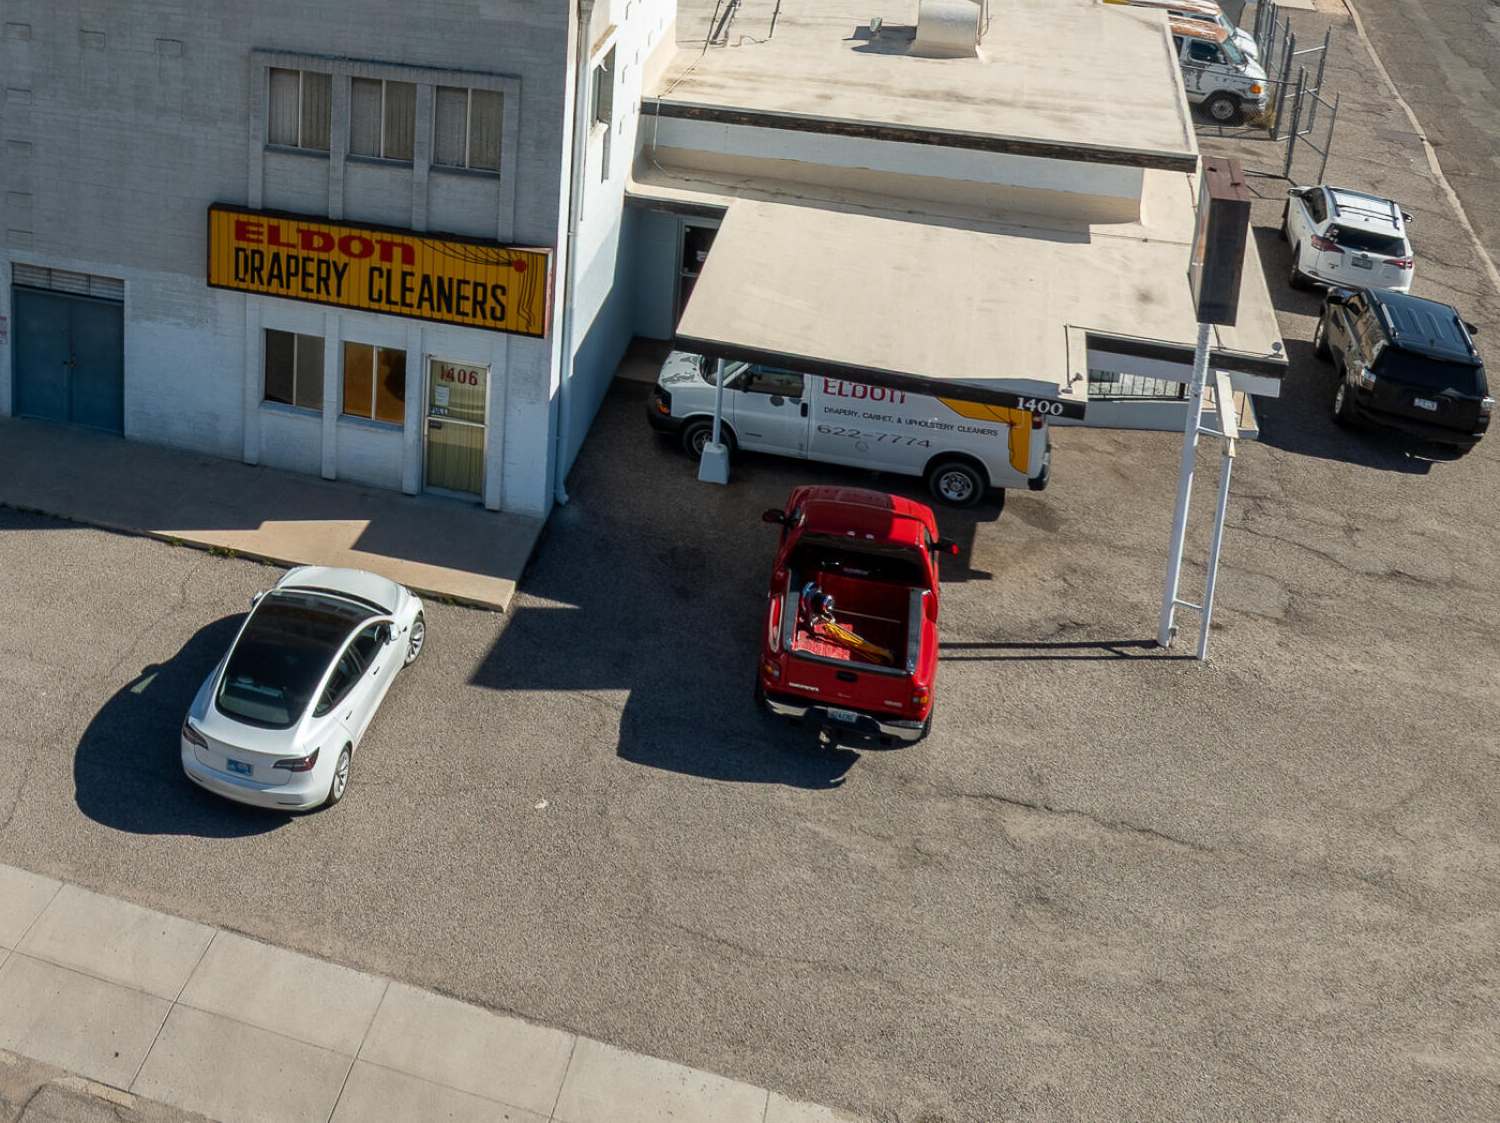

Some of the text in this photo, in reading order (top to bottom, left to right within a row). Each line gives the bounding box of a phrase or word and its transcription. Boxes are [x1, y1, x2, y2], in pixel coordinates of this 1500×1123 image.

[234, 247, 507, 322] DRAPERY CLEANERS
[440, 365, 479, 386] 1406
[1017, 397, 1063, 416] 1400
[817, 424, 931, 448] 622-7774
[905, 418, 955, 432] UPHOLSTERY
[957, 425, 998, 437] CLEANERS
